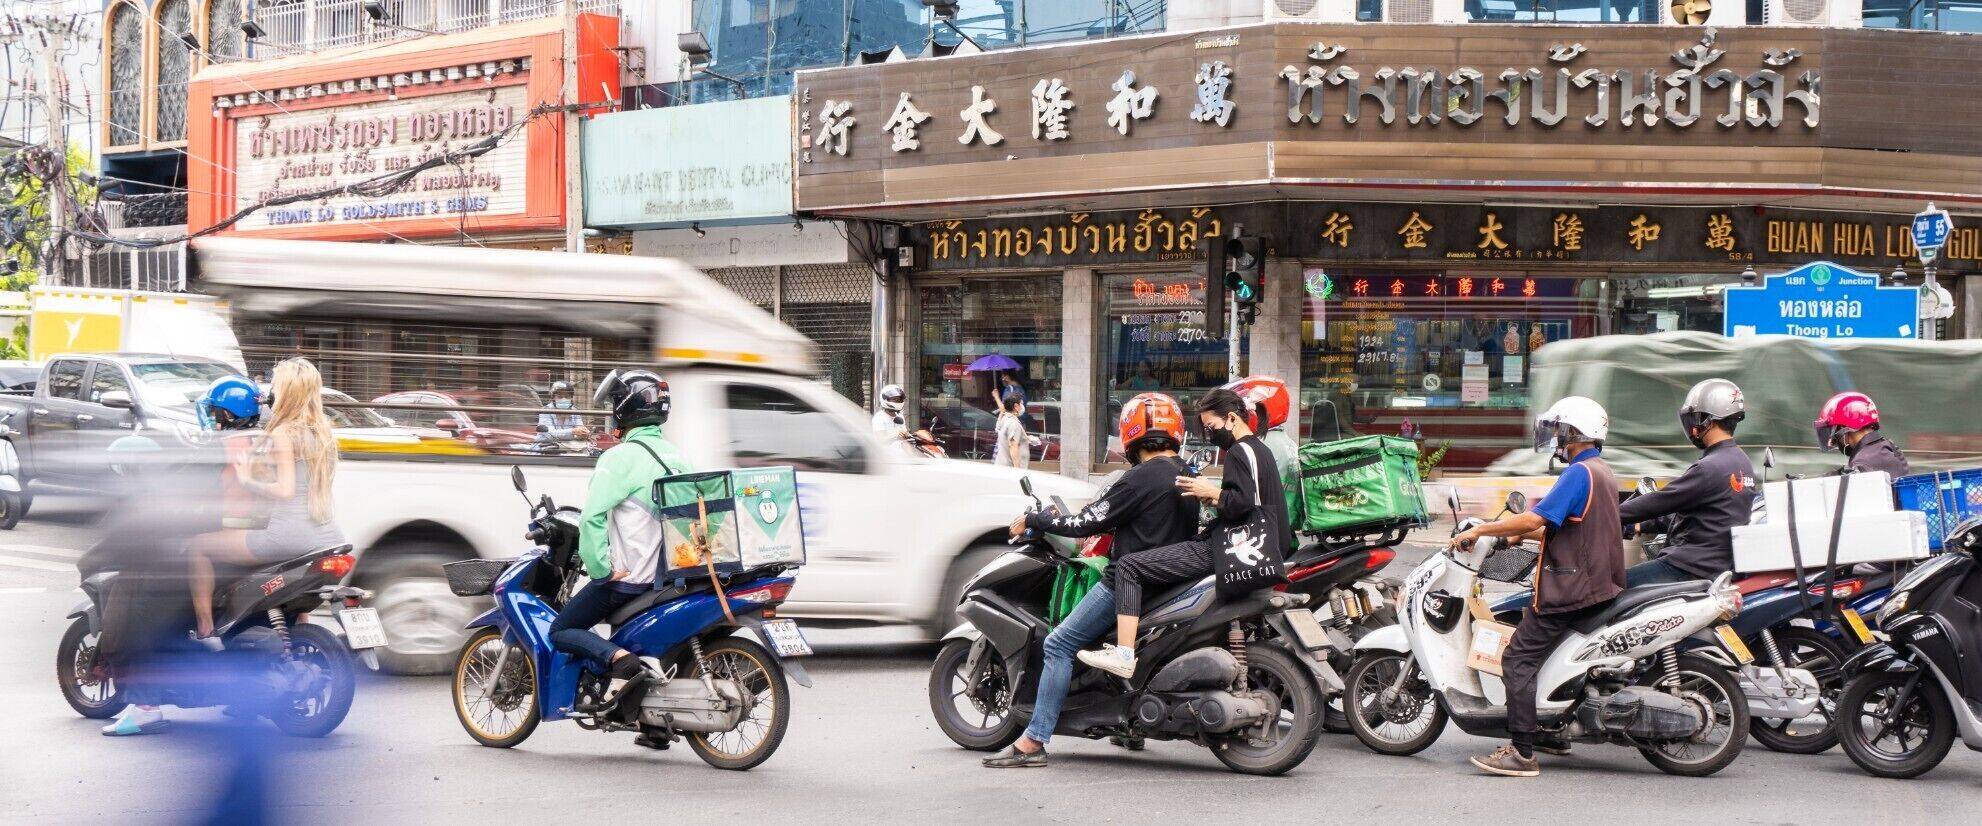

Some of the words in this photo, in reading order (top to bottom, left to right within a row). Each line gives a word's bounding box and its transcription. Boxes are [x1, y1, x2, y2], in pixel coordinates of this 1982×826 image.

[266, 208, 313, 226] THONG
[317, 207, 335, 221] LO
[342, 201, 425, 220] GOLDSMITH
[447, 196, 489, 213] GEMS
[1935, 219, 1945, 237] 55
[1767, 221, 1823, 253] BUAN
[1834, 223, 1875, 256] HUA
[1886, 225, 1918, 257] LO
[1728, 252, 1753, 261] 58/4
[1785, 277, 1806, 286] แยก
[1838, 277, 1874, 286] Junction
[1779, 294, 1862, 319] ทองหล่อ
[1786, 324, 1829, 339] Thong
[1836, 324, 1854, 337] Lo
[1224, 570, 1253, 584] SPACE
[1259, 565, 1276, 577] CAT
[1911, 627, 1940, 641] YAMAHA
